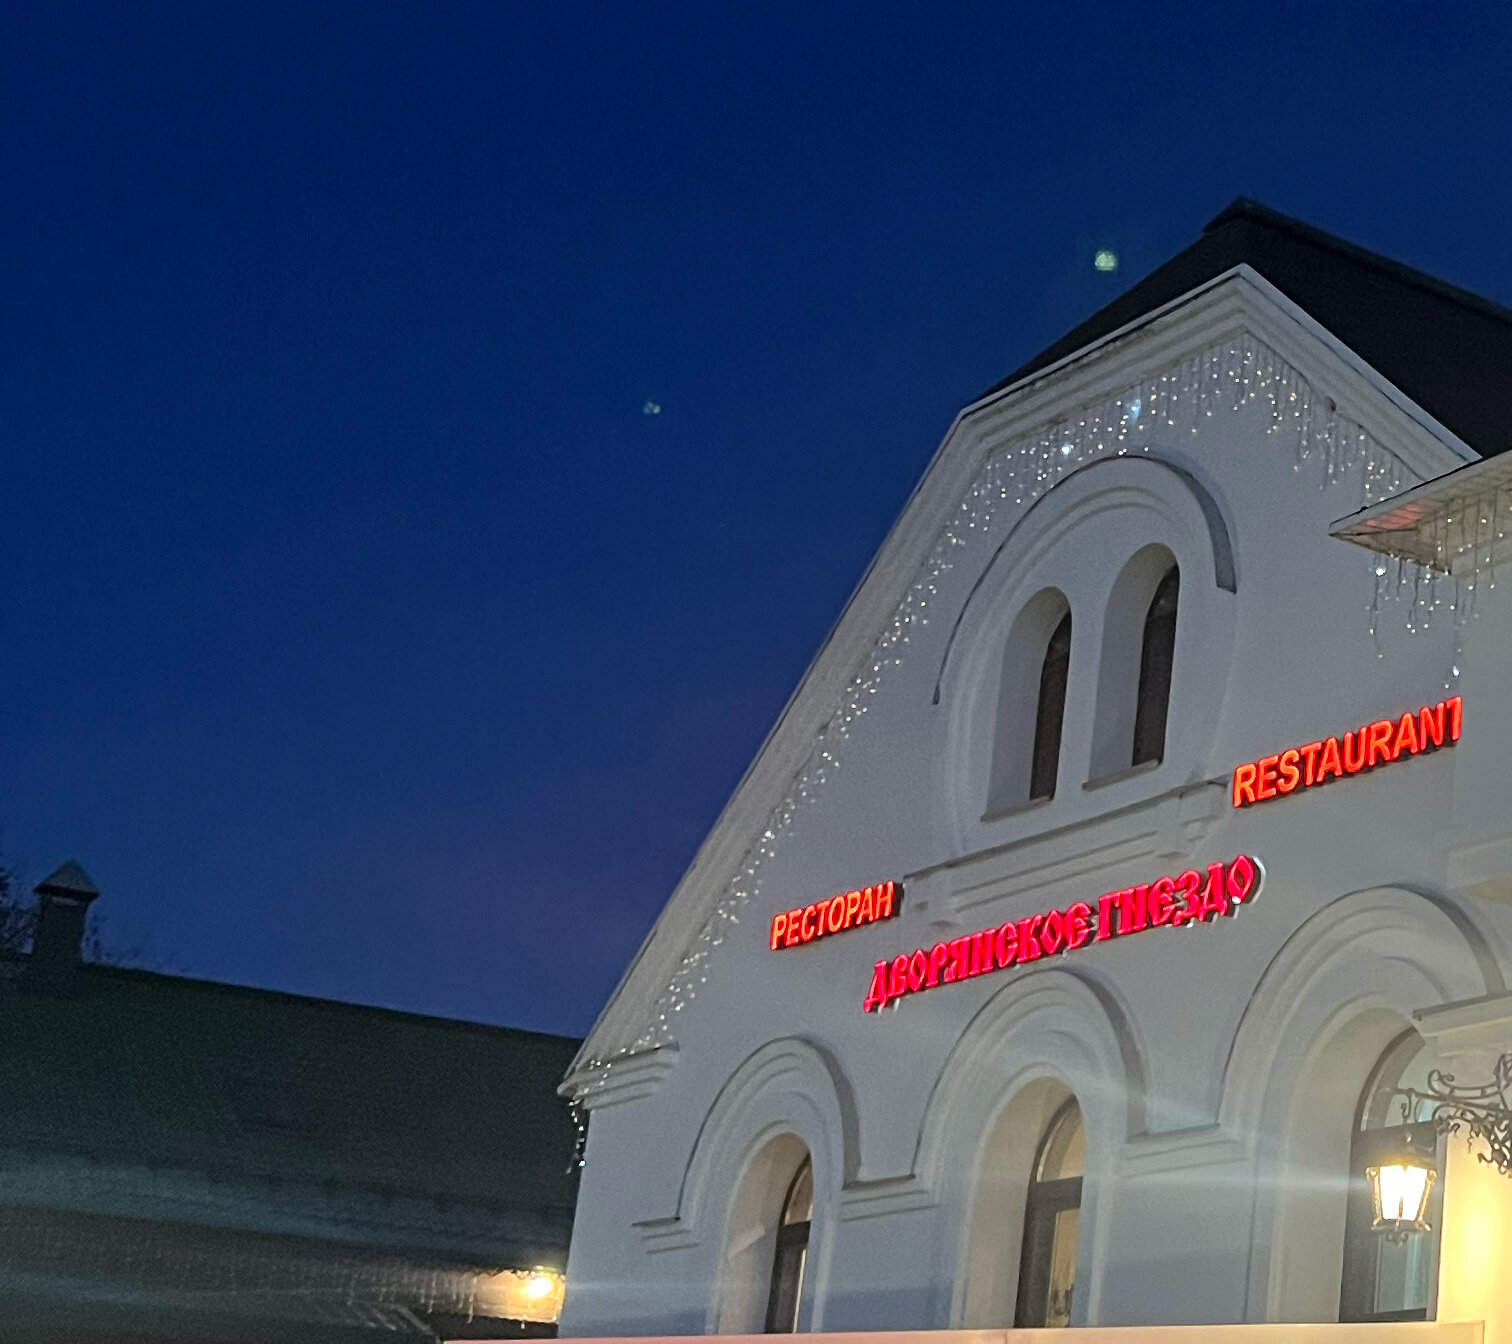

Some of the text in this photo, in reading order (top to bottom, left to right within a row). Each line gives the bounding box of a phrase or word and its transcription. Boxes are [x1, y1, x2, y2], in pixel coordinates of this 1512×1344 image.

[1232, 695, 1464, 808] RESTAURANT
[770, 880, 896, 952] РЕСТОРАН
[863, 900, 1093, 1013] ДВОРЯНСКОЕ
